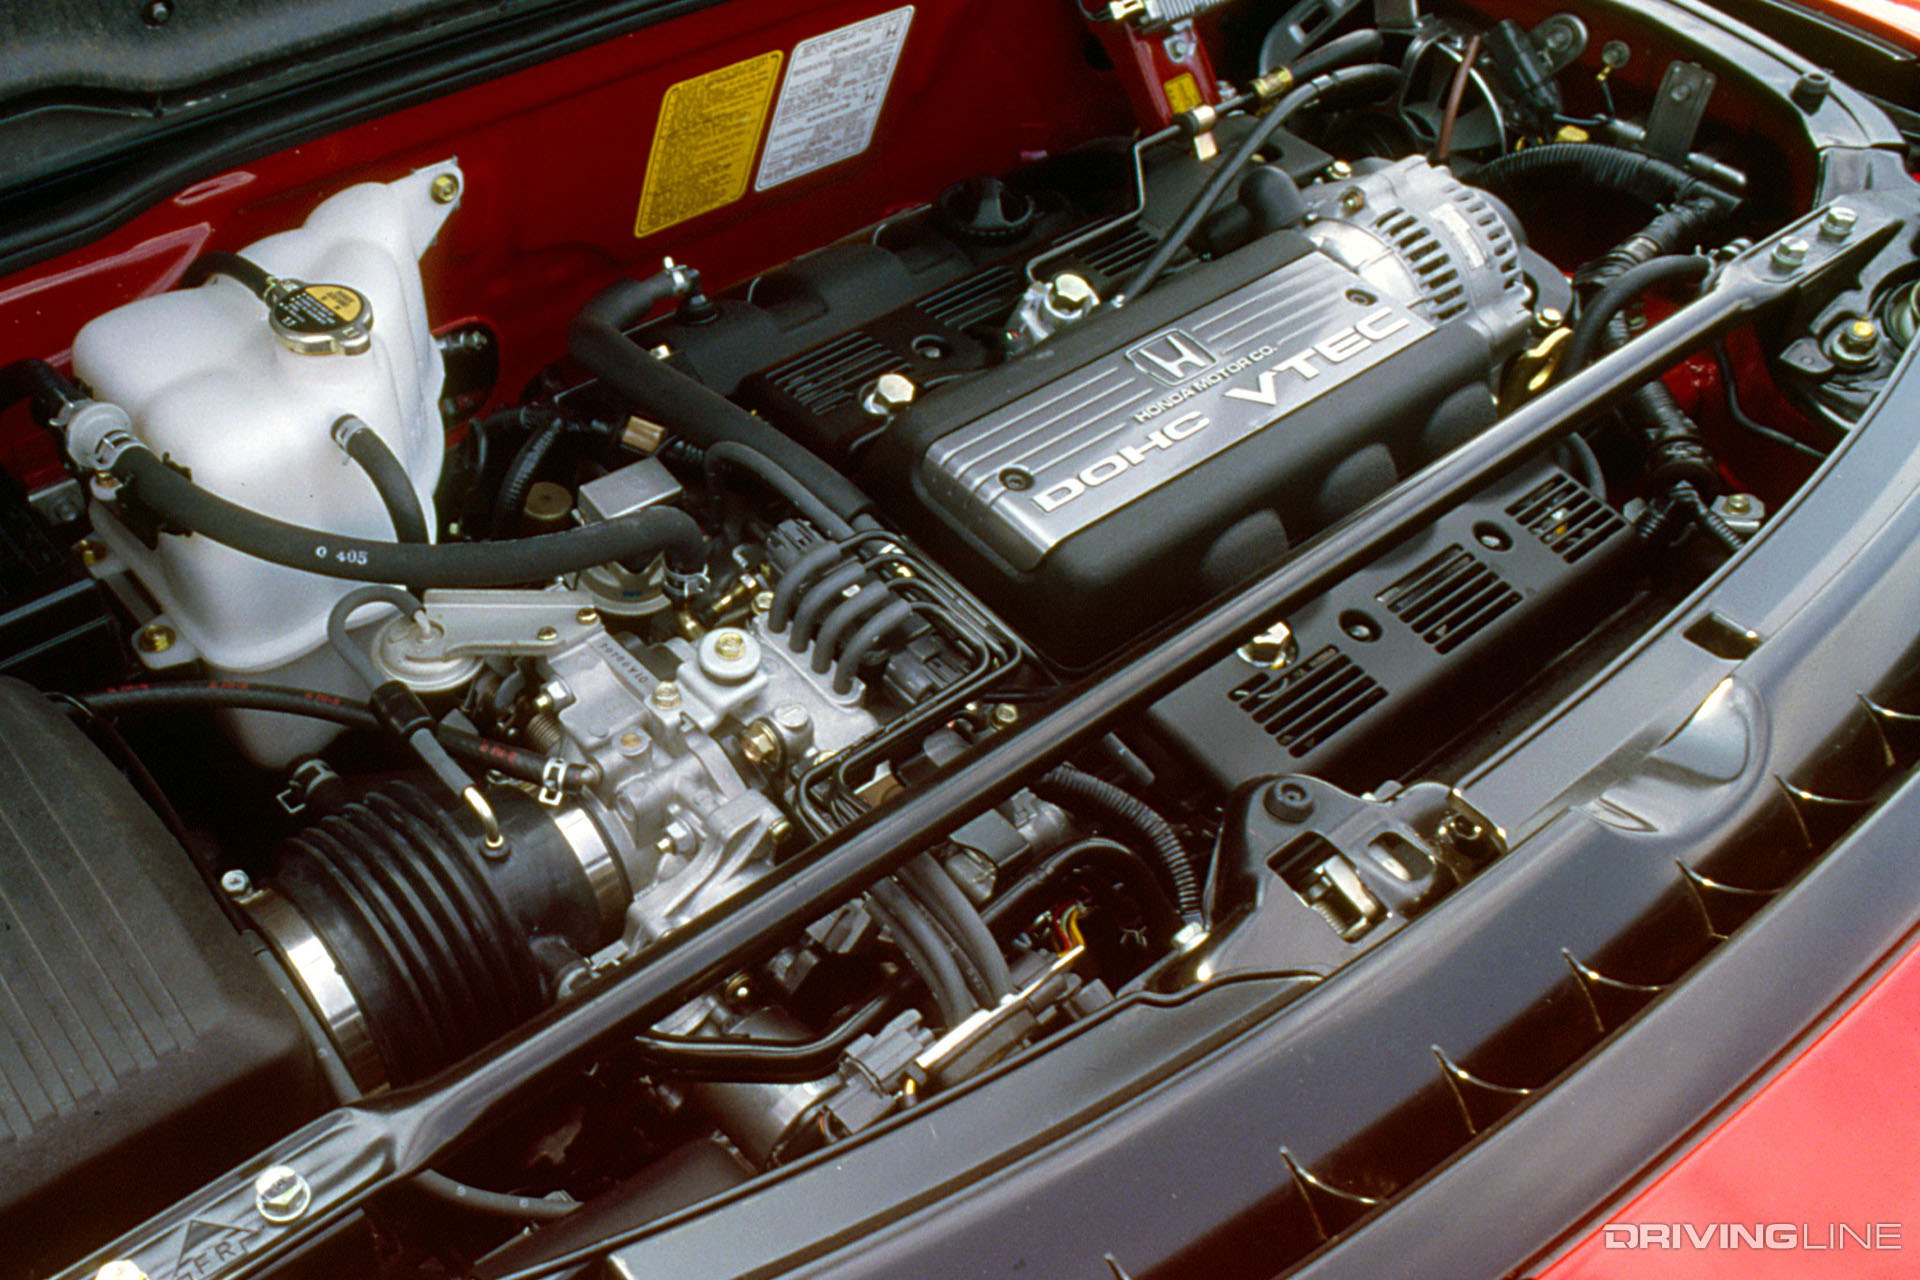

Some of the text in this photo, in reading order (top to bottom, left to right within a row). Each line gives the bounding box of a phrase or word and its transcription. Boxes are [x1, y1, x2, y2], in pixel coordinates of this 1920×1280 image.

[1032, 305, 1410, 514] DOHC VTEC
[1134, 344, 1279, 424] HONDA MOTOR CO.
[335, 549, 369, 566] 405
